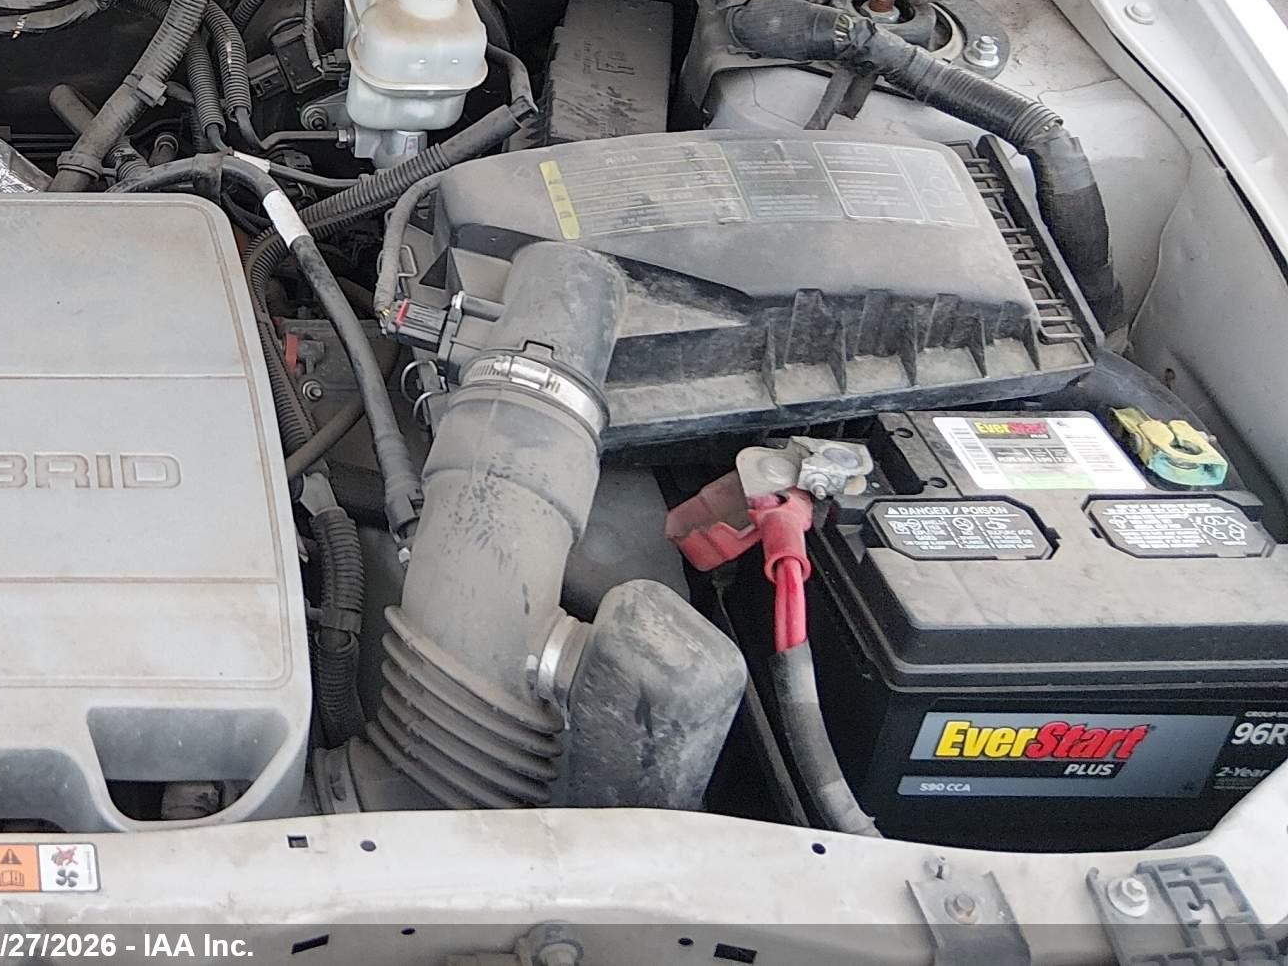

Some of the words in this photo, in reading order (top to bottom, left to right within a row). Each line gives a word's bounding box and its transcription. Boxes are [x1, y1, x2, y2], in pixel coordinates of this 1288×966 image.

[898, 506, 949, 515] DANGER
[961, 506, 1008, 515] POISON
[934, 720, 1151, 759] EverStart
[1230, 722, 1288, 745] 96R
[1064, 763, 1114, 776] PLUS
[919, 782, 944, 792] 590
[946, 782, 971, 792] CCA
